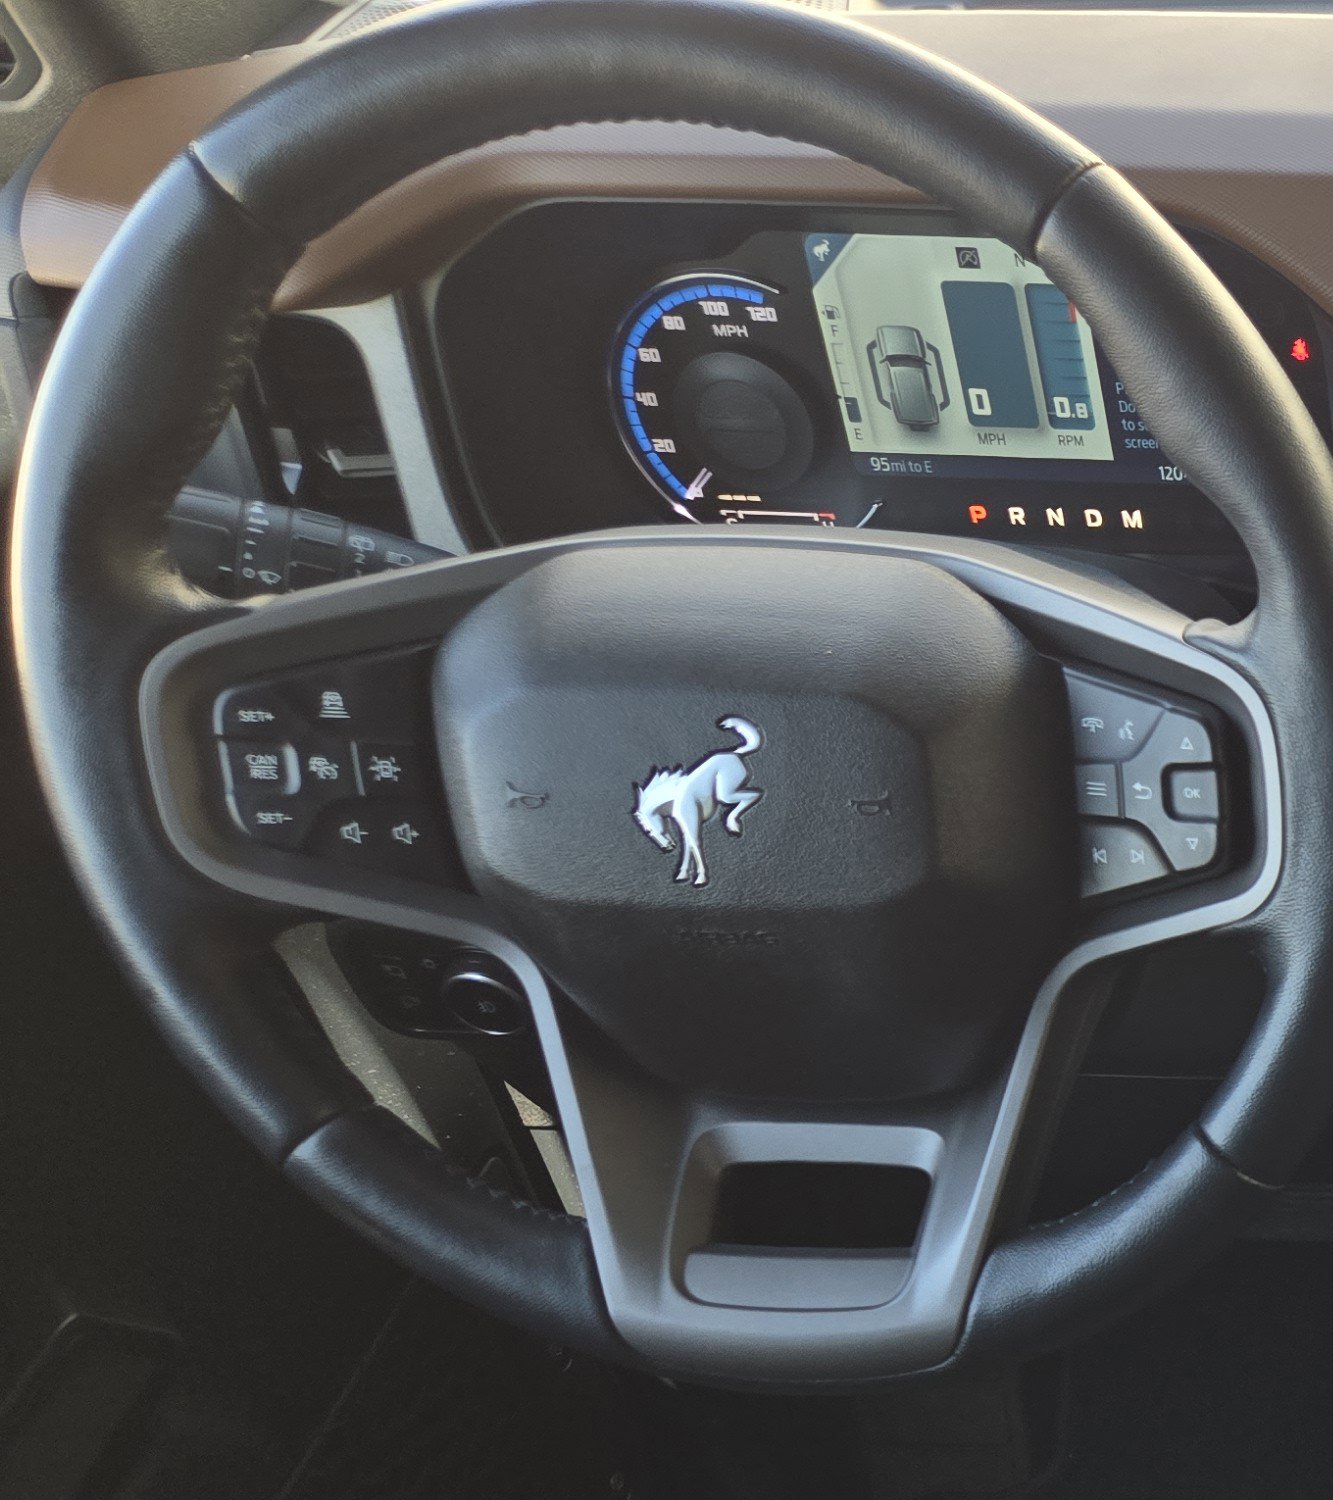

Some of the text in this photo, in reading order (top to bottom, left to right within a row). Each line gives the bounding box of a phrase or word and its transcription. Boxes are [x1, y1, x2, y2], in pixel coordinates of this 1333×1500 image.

[698, 301, 730, 316] 100
[745, 306, 778, 322] 120
[662, 316, 685, 331] 80
[712, 324, 749, 338] MPH
[831, 325, 839, 337] F
[638, 348, 661, 363] 60
[635, 392, 659, 406] 40
[968, 388, 992, 416] 0
[1054, 397, 1088, 418] 0.8
[1121, 419, 1135, 431] to
[854, 428, 863, 440] E
[977, 433, 1006, 446] MPH
[1057, 434, 1085, 447] RPM
[652, 439, 676, 453] 20
[910, 460, 923, 473] to
[925, 461, 933, 473] E
[968, 505, 1144, 529] P R N D M
[251, 768, 278, 780] RES
[1183, 788, 1201, 799] OK
